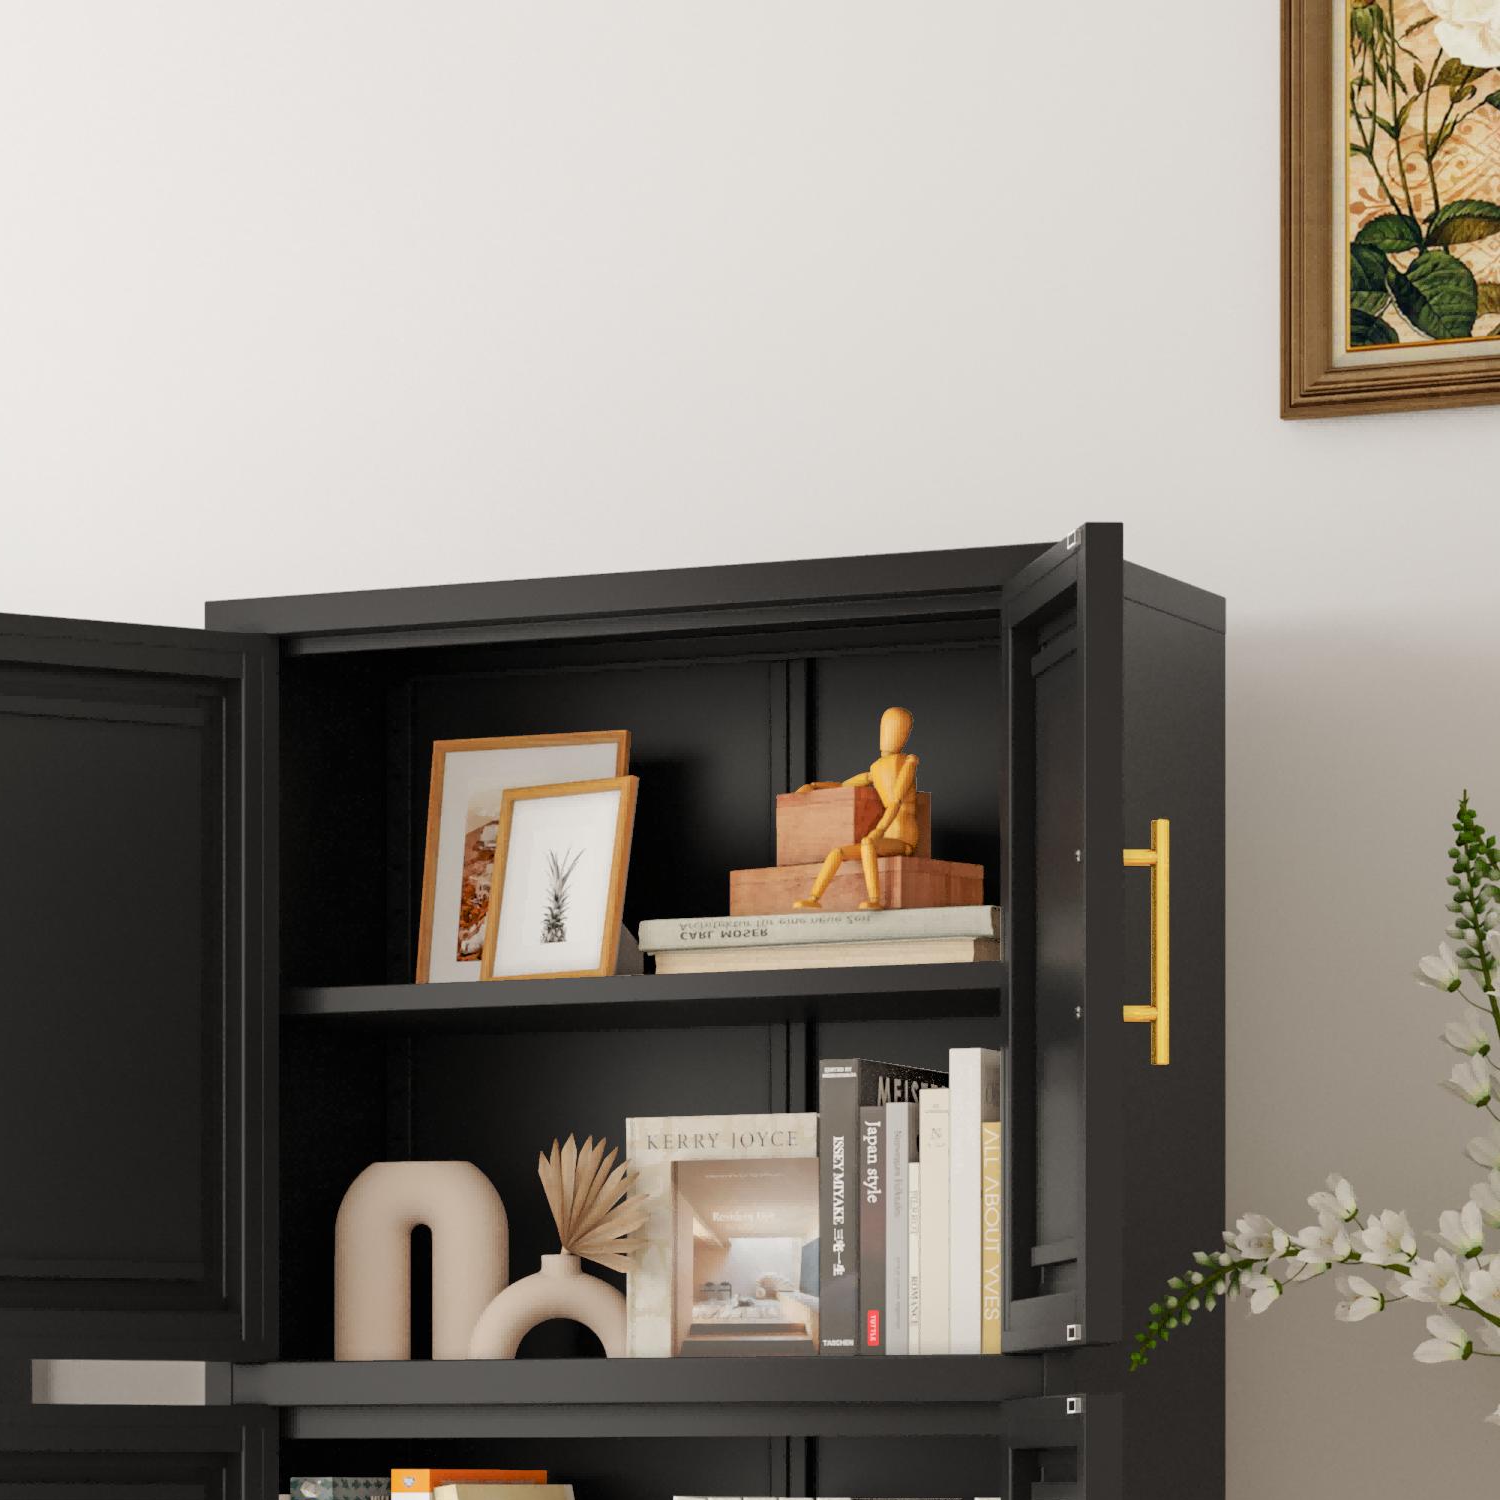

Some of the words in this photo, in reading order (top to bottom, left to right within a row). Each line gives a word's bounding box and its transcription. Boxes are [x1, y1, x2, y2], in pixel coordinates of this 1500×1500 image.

[647, 1132, 720, 1150] KERRY
[731, 1130, 799, 1149] JOYCE
[832, 1135, 845, 1172] ISSEY
[863, 1120, 881, 1164] Japan
[983, 1127, 1000, 1168] ALL
[832, 1172, 845, 1225] MIYAKE
[863, 1168, 881, 1204] style
[983, 1175, 1000, 1254] ABOUT
[983, 1263, 1000, 1321] YVES
[822, 1338, 855, 1347] TASCHEN
